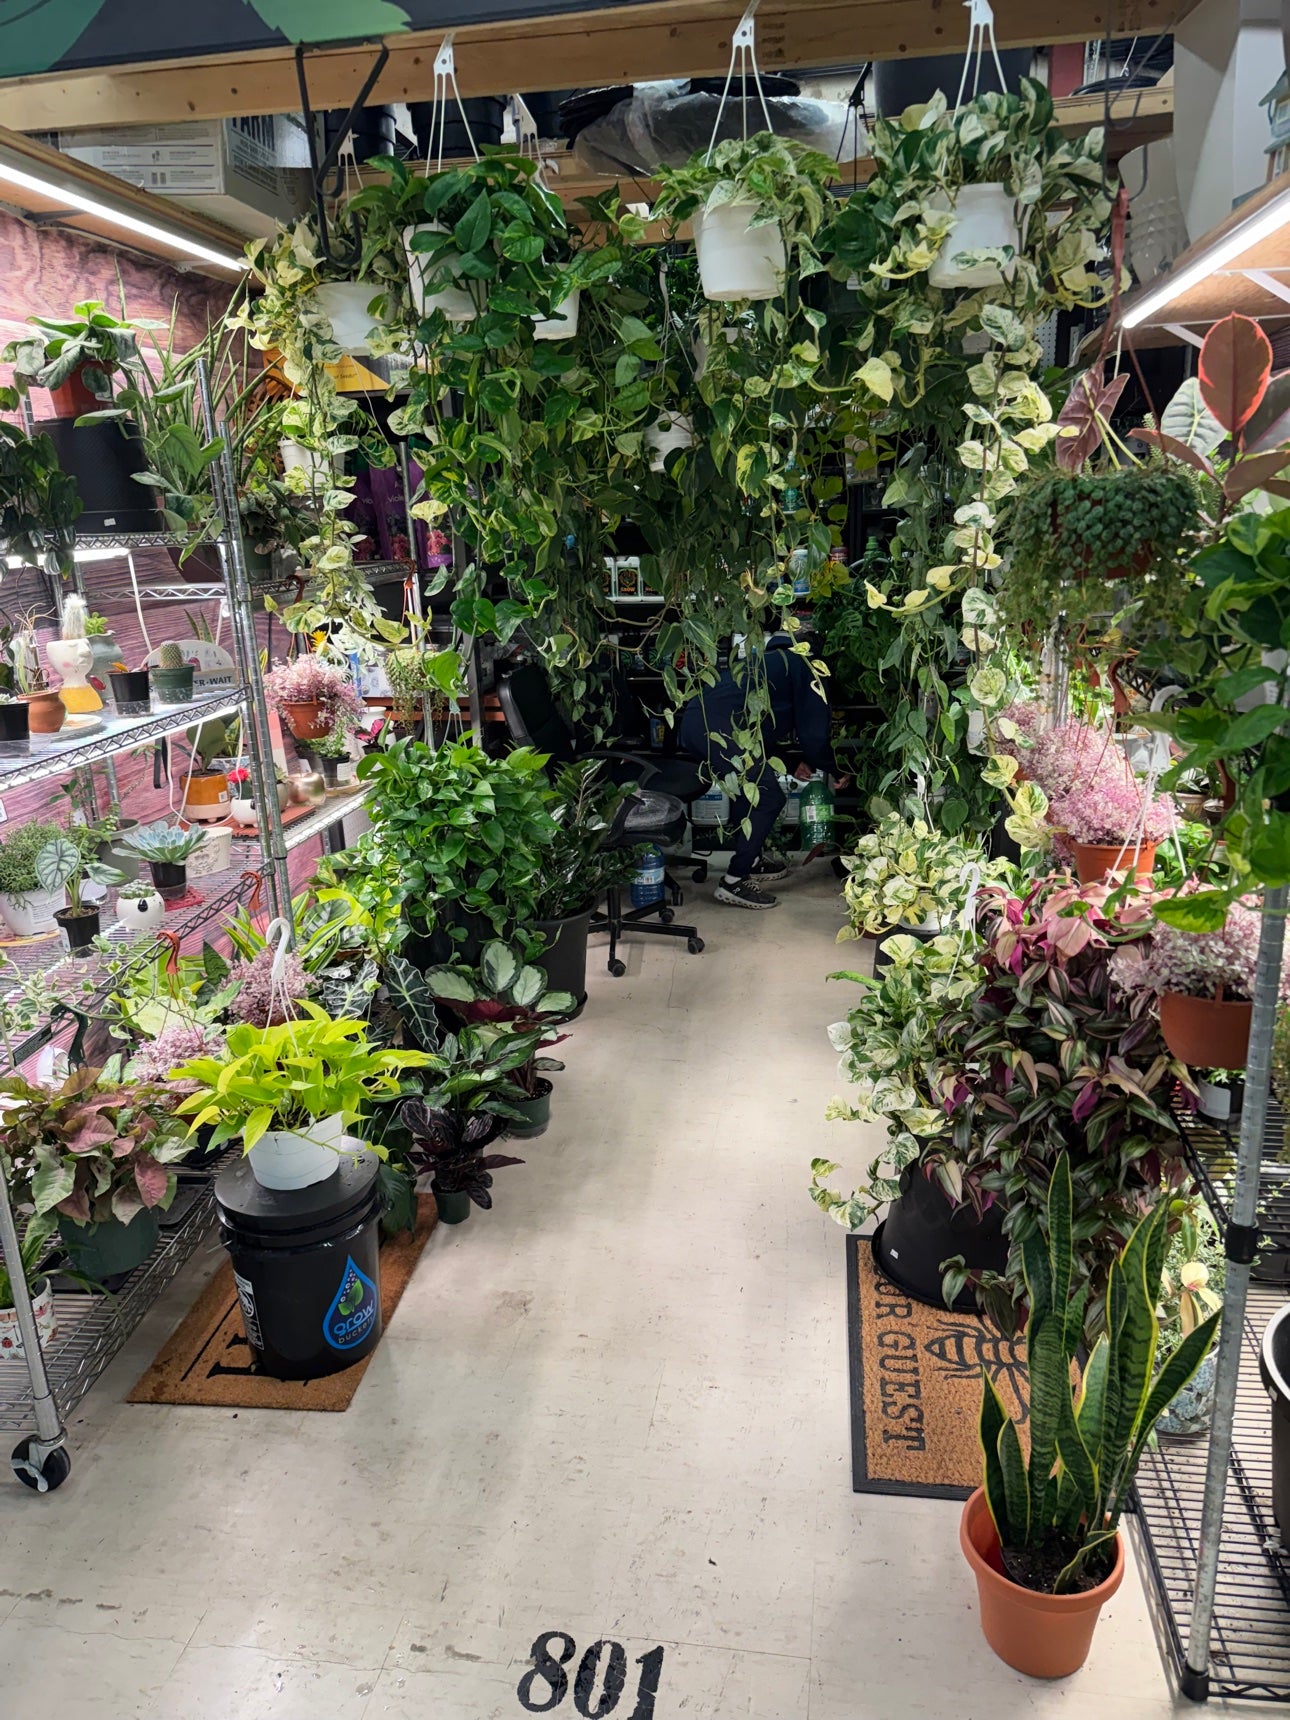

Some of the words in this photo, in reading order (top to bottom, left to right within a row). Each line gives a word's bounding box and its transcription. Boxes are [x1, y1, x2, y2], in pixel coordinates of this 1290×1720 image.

[334, 1299, 374, 1337] grow
[877, 1330, 926, 1451] GUEST
[516, 1631, 665, 1720] 801
